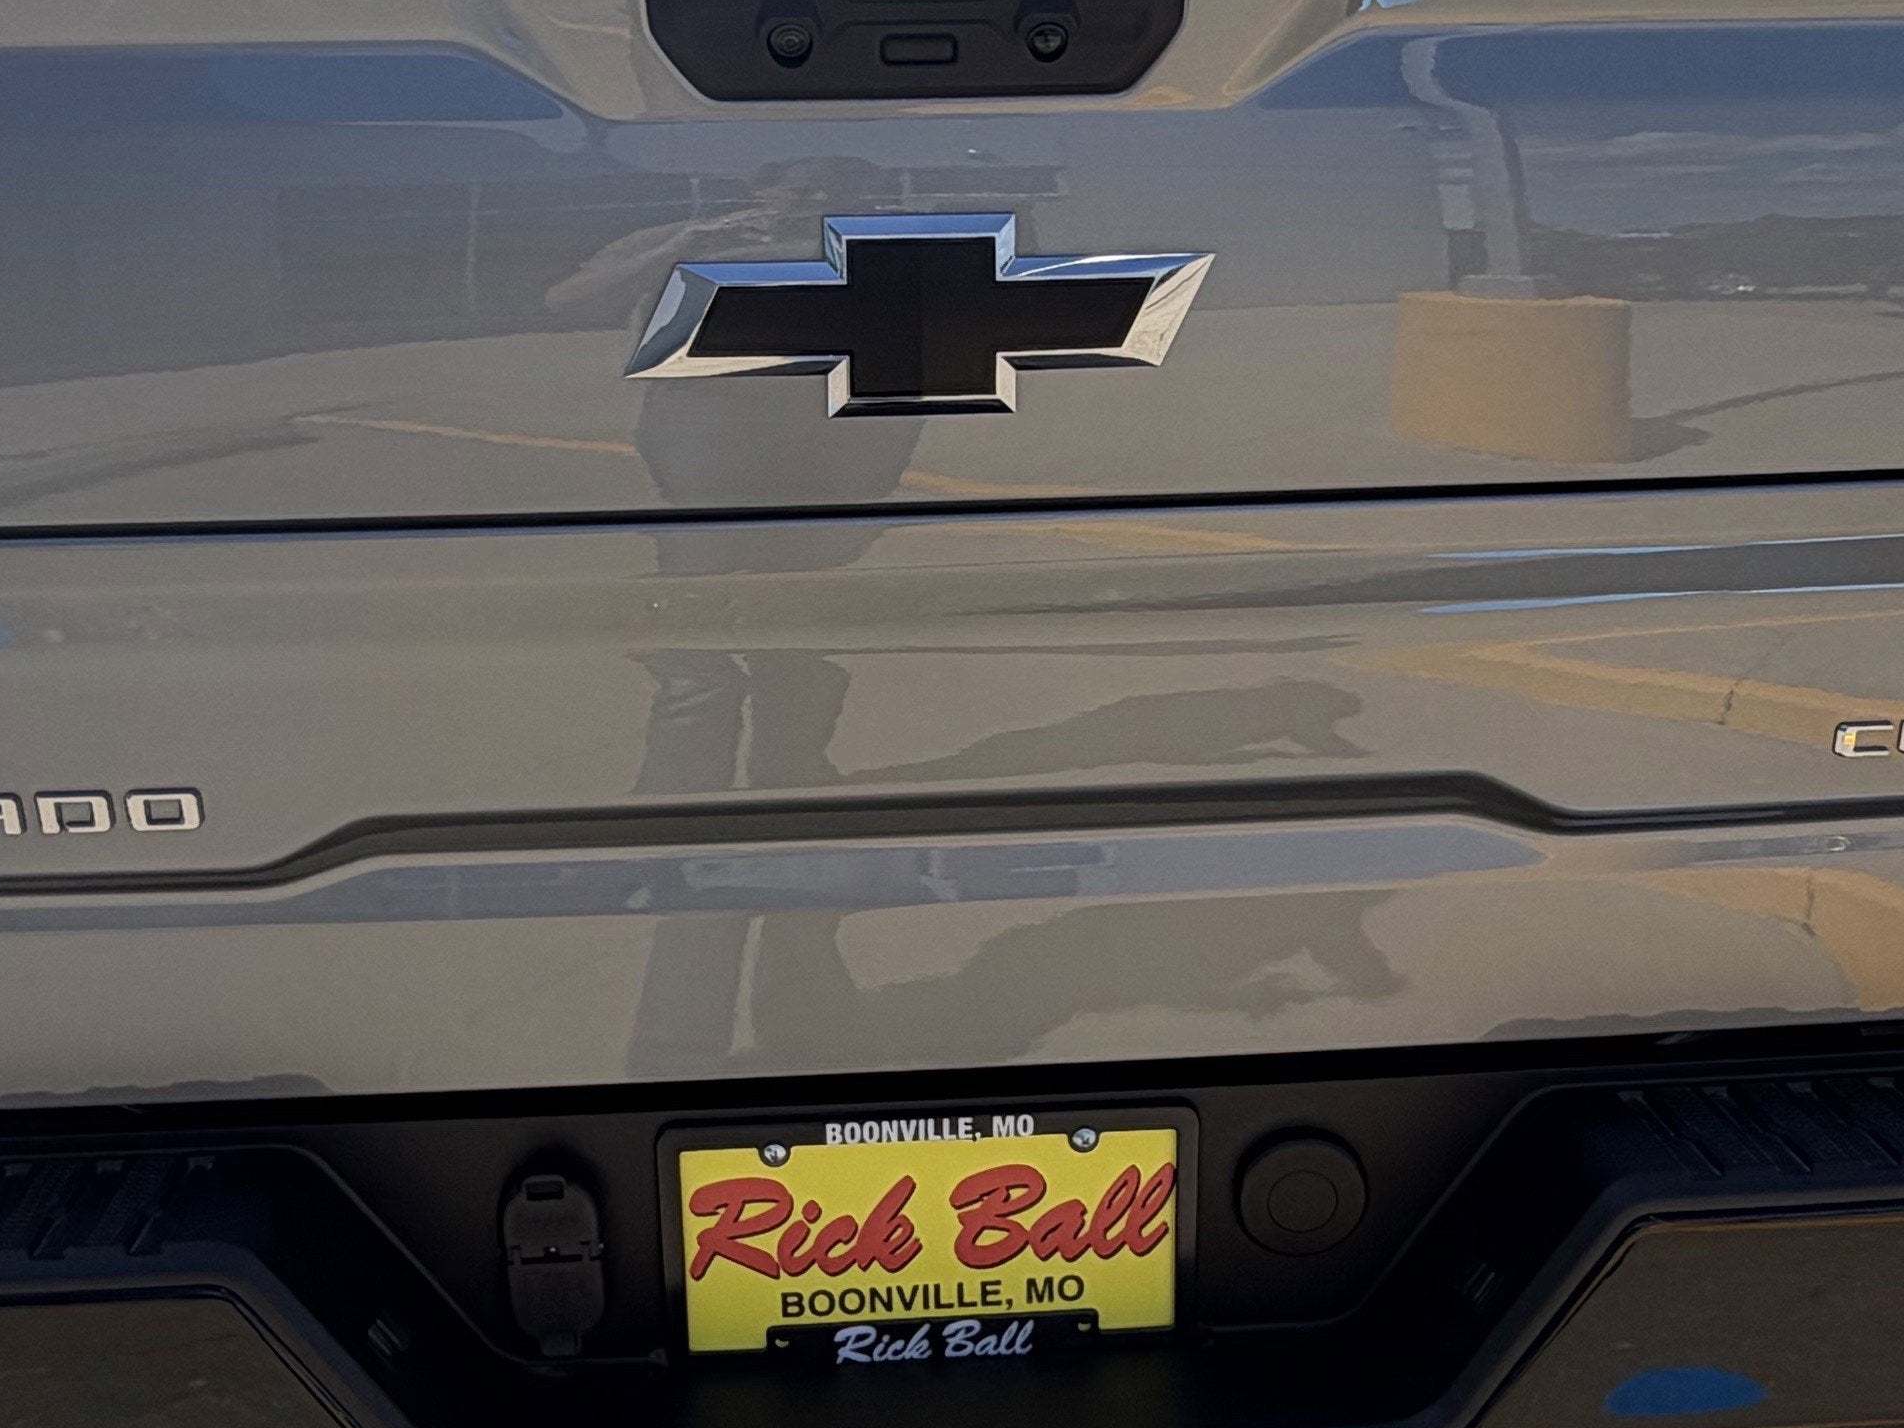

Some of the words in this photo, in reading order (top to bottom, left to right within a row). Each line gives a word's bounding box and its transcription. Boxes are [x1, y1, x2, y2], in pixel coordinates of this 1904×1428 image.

[825, 1116, 982, 1146] BOONVILLE,
[992, 1114, 1035, 1138] MO
[689, 1175, 923, 1282] Rick
[949, 1163, 1178, 1270] Ball
[781, 1279, 1014, 1318] BOONVILLE,
[1025, 1274, 1086, 1305] MO
[834, 1325, 933, 1365] Rick
[942, 1320, 1034, 1358] Ball
